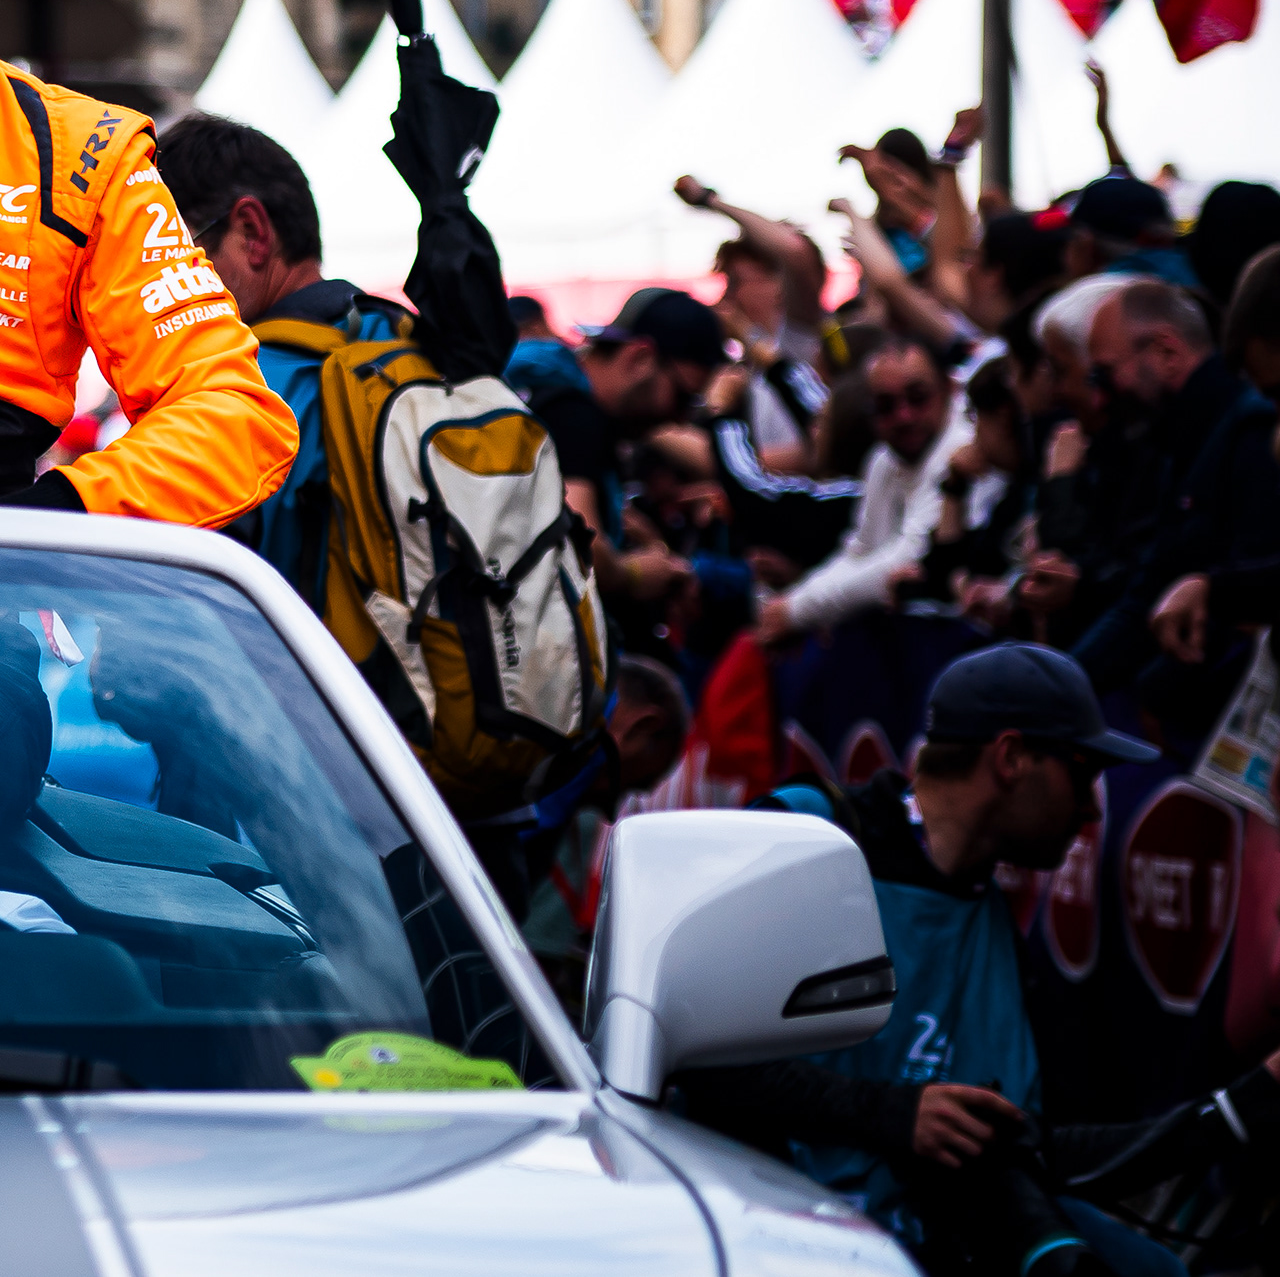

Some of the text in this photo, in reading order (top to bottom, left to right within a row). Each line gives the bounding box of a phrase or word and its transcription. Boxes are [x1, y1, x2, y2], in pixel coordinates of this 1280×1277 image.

[69, 109, 124, 195] HRX
[142, 247, 196, 263] LE MAN
[154, 303, 236, 340] INSURANCE
